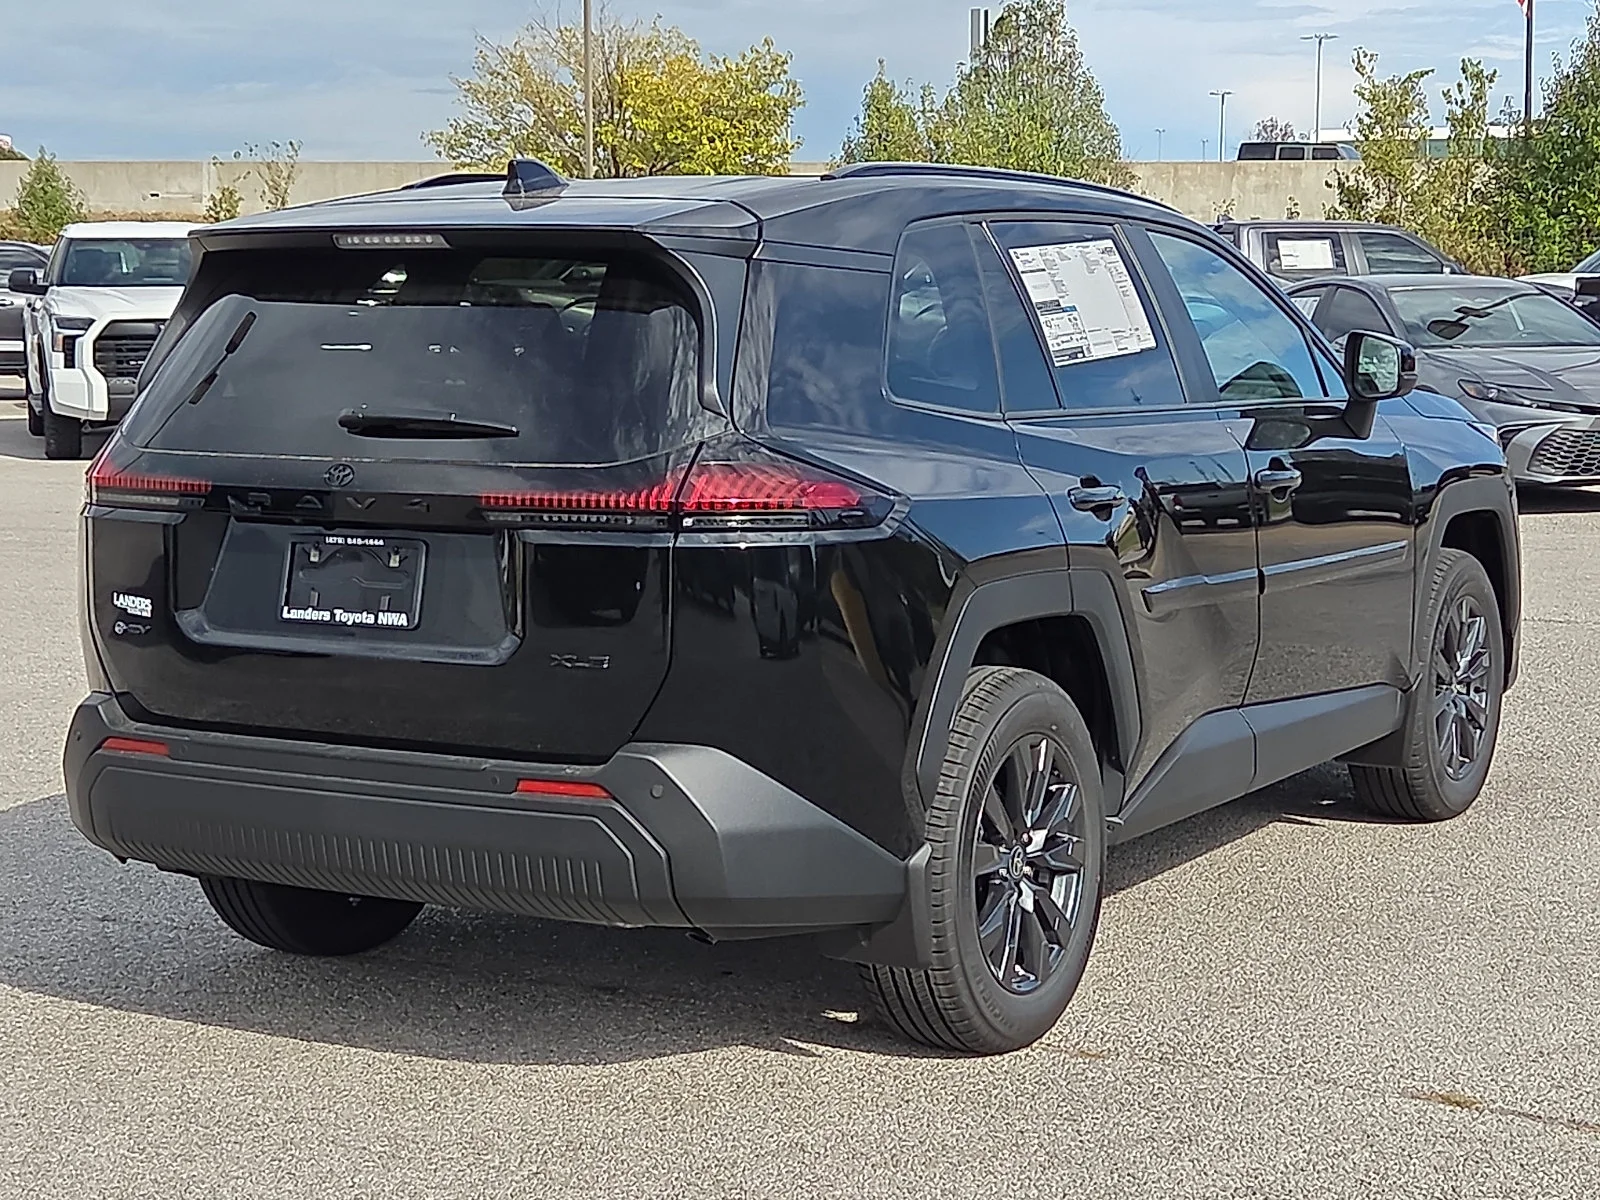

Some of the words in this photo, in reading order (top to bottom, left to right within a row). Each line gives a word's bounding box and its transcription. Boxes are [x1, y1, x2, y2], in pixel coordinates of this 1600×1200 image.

[113, 591, 153, 610] LANDERS
[282, 606, 331, 621] Landers
[333, 608, 375, 625] Toyota
[377, 612, 408, 627] NWA
